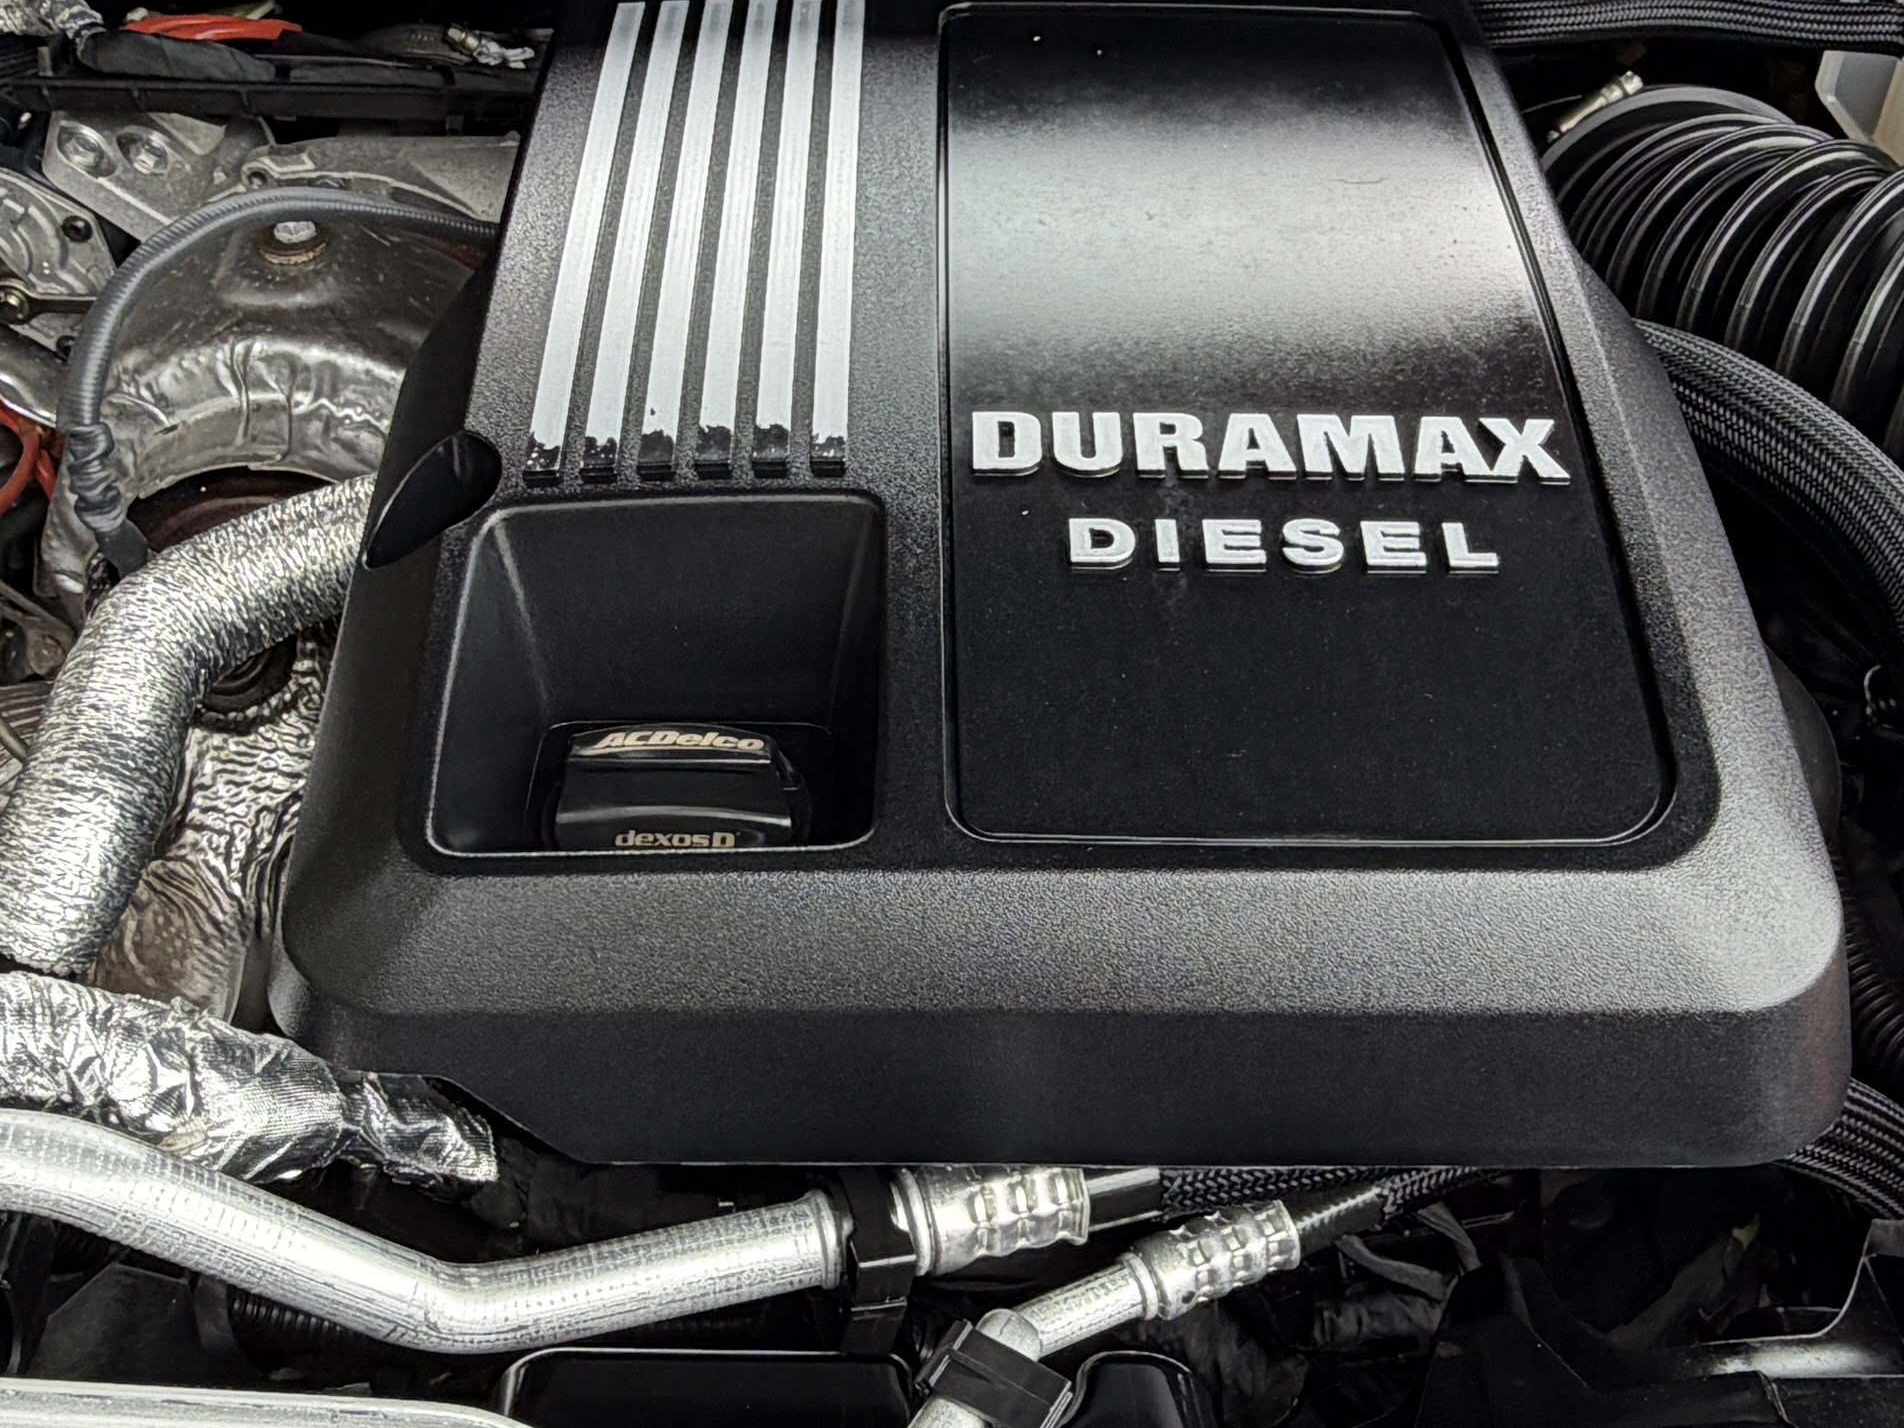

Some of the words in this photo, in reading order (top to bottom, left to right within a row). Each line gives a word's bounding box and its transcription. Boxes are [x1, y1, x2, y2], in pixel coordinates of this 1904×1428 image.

[971, 410, 1571, 484] DURAMAX
[1069, 517, 1500, 575] DIESEL
[593, 730, 765, 750] ACDelco
